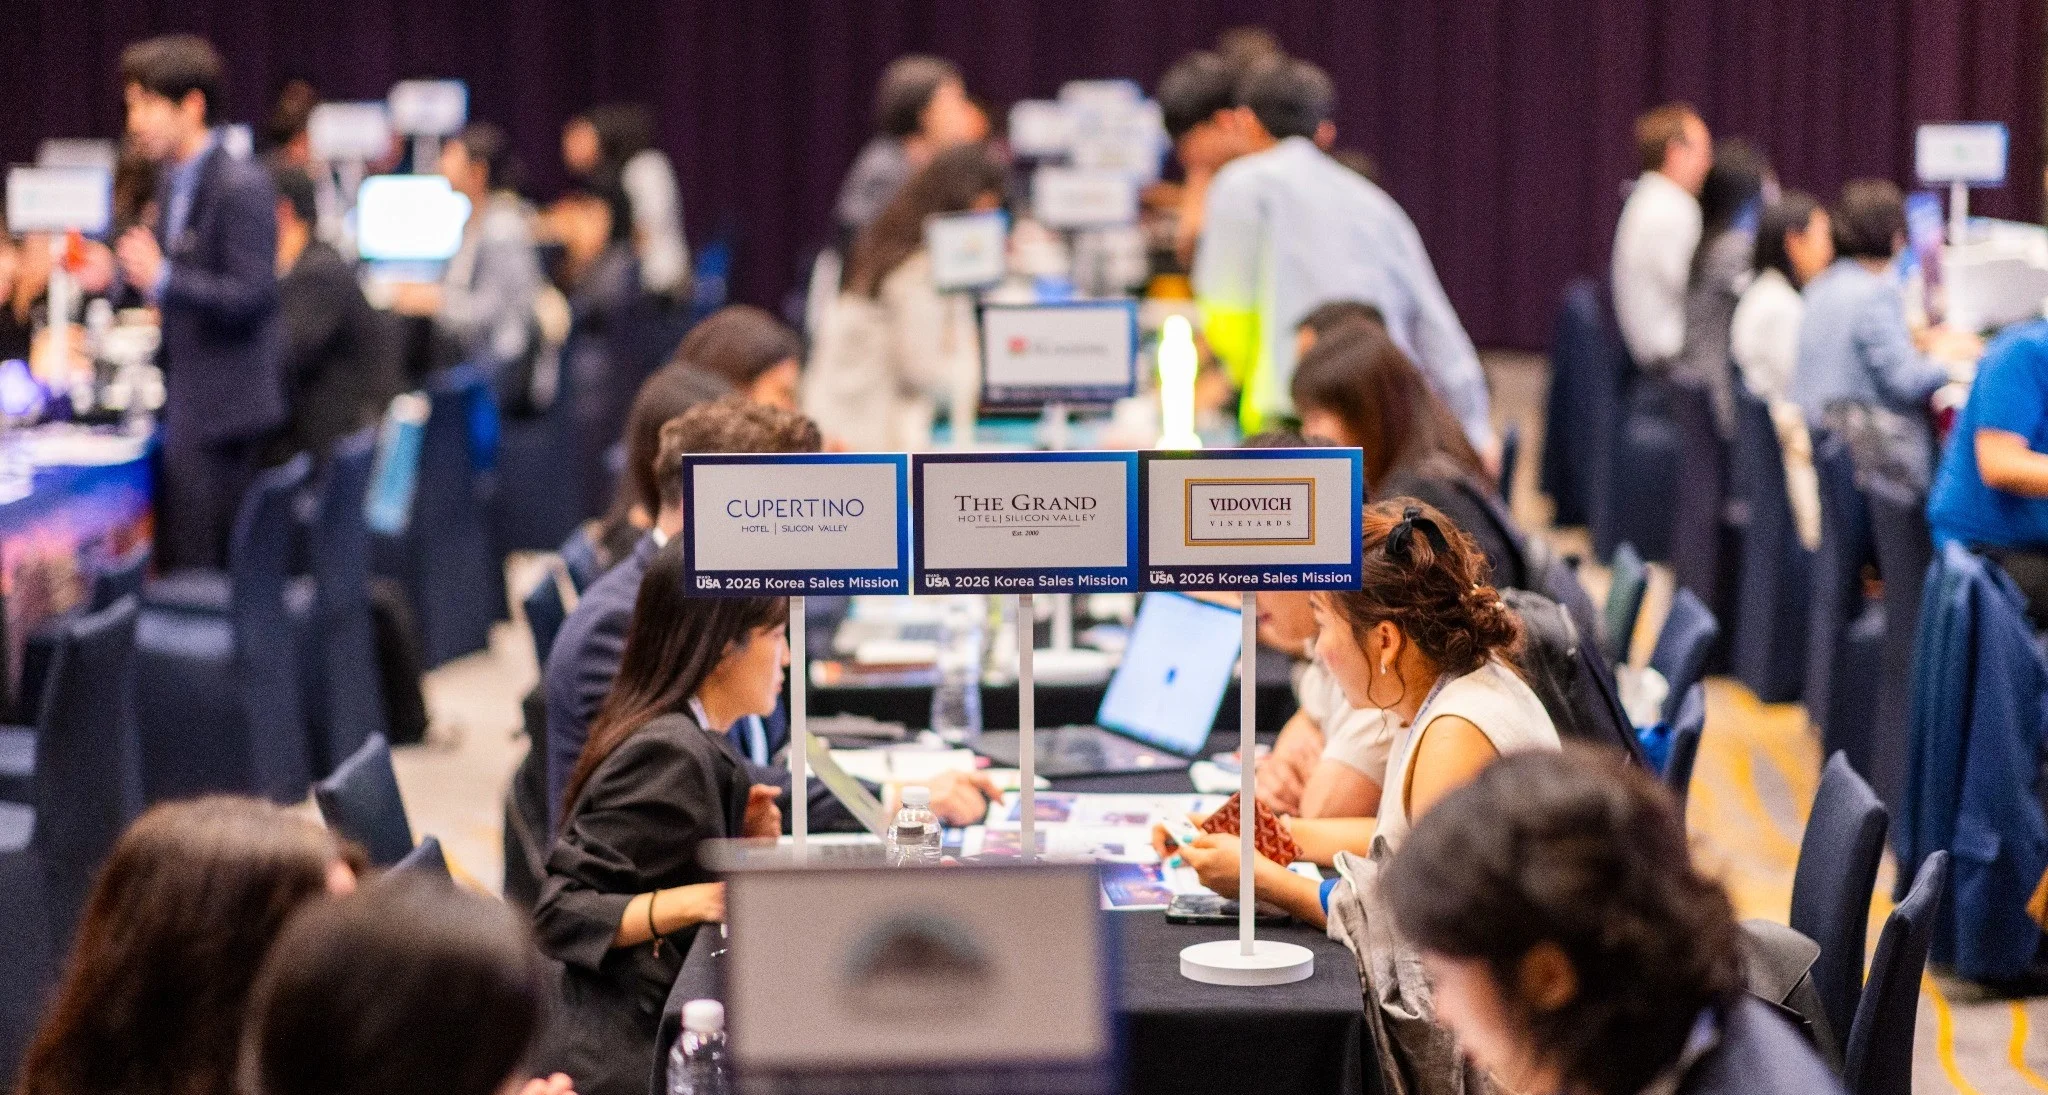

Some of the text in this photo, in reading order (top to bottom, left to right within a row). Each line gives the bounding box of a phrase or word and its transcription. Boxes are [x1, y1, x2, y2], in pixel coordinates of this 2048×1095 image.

[727, 498, 864, 518] CUPERTINO
[954, 494, 1097, 512] THE GRAND
[1209, 498, 1292, 511] VIDOVICH
[958, 514, 1096, 523] HOTEL SILICON VALLEY
[741, 524, 848, 533] HOTEL SILICON VALLEY
[696, 576, 899, 589] USA 2026 Korea Sales Mission
[925, 574, 1128, 588] USA 2026 Korea Sales Mission
[1149, 571, 1352, 584] USA 2026 Korea Sales Mission
